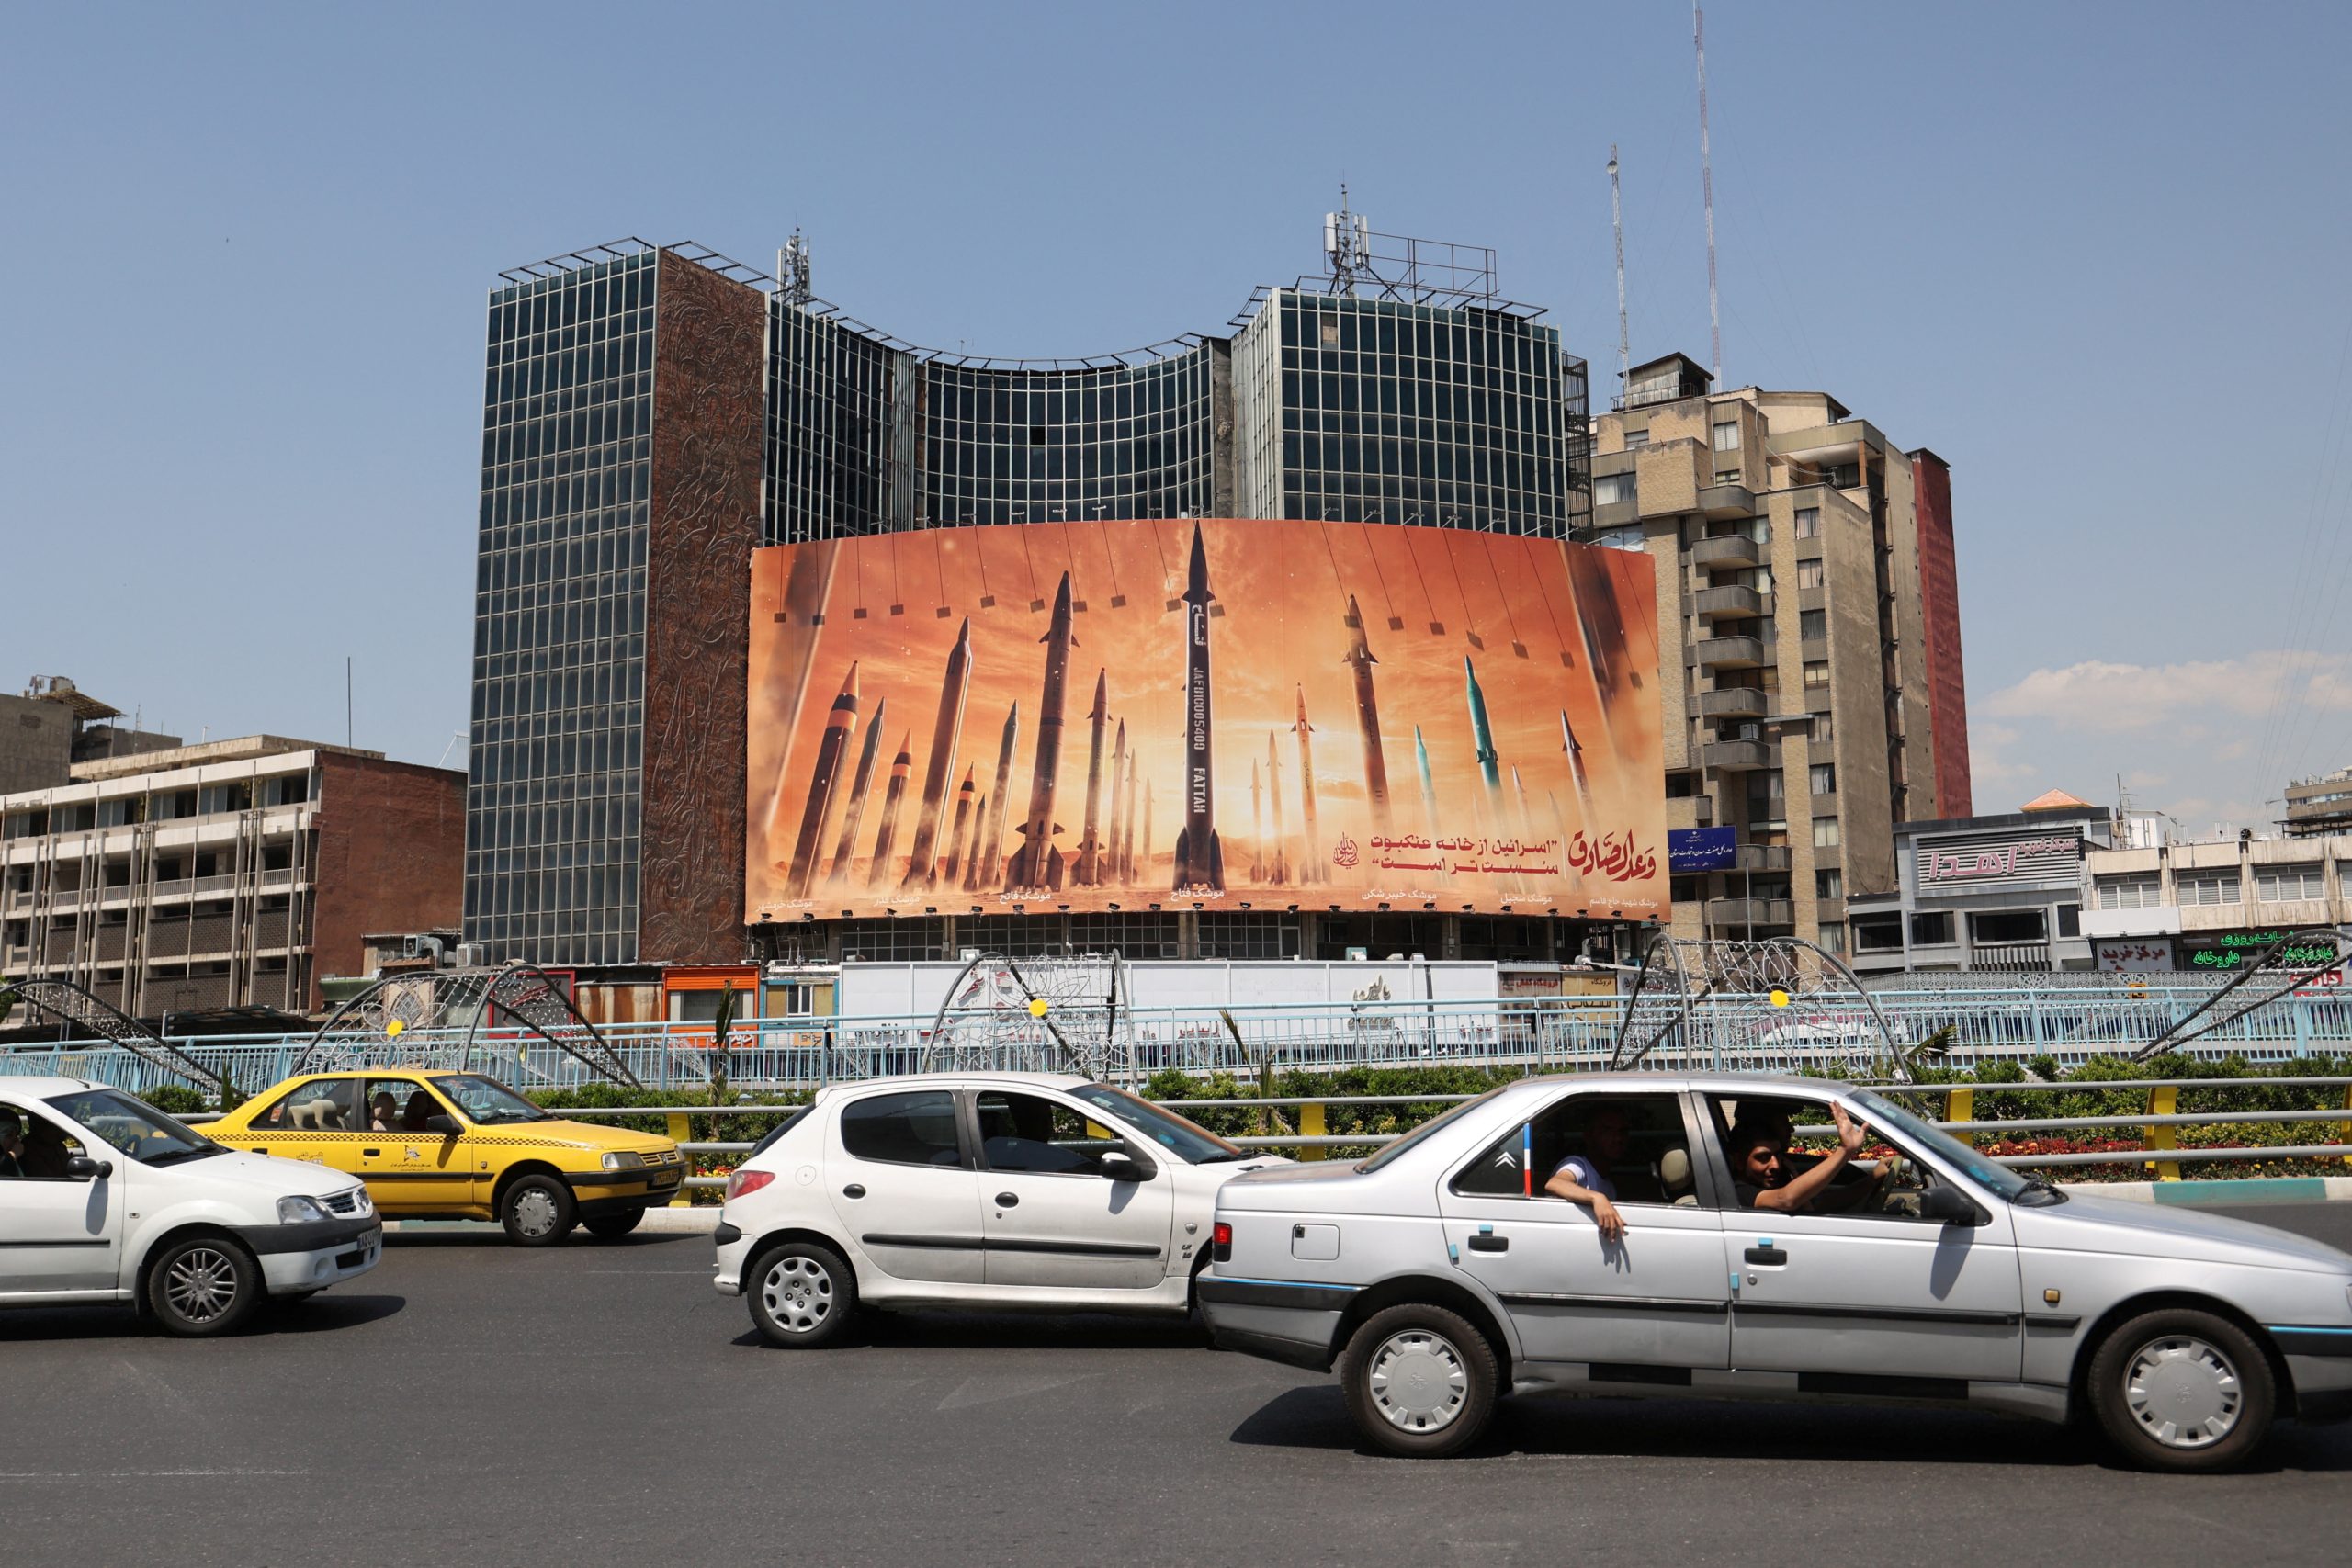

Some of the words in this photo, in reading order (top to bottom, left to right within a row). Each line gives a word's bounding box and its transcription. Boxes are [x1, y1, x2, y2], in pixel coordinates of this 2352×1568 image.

[1193, 768, 1205, 813] FATTAH
[1370, 834, 1431, 852] عنکبوت
[1435, 837, 1474, 851] خانه
[1476, 838, 1487, 855] از
[1451, 859, 1479, 874] تر
[1929, 845, 2018, 878] اهدا
[999, 892, 1019, 904] فاتح
[1020, 891, 1051, 902] موشک
[1170, 888, 1192, 899] فتاح
[1193, 888, 1224, 898] موشک
[1361, 888, 1385, 900] شکن
[1385, 888, 1407, 900] خیبر
[1408, 889, 1437, 901] موشک
[1500, 892, 1523, 904] سجیل
[1526, 893, 1553, 904] موشک
[891, 895, 920, 904] موشک
[2102, 945, 2133, 964] خرید
[2135, 945, 2165, 961] مرکز
[2193, 950, 2240, 968] داروخانه
